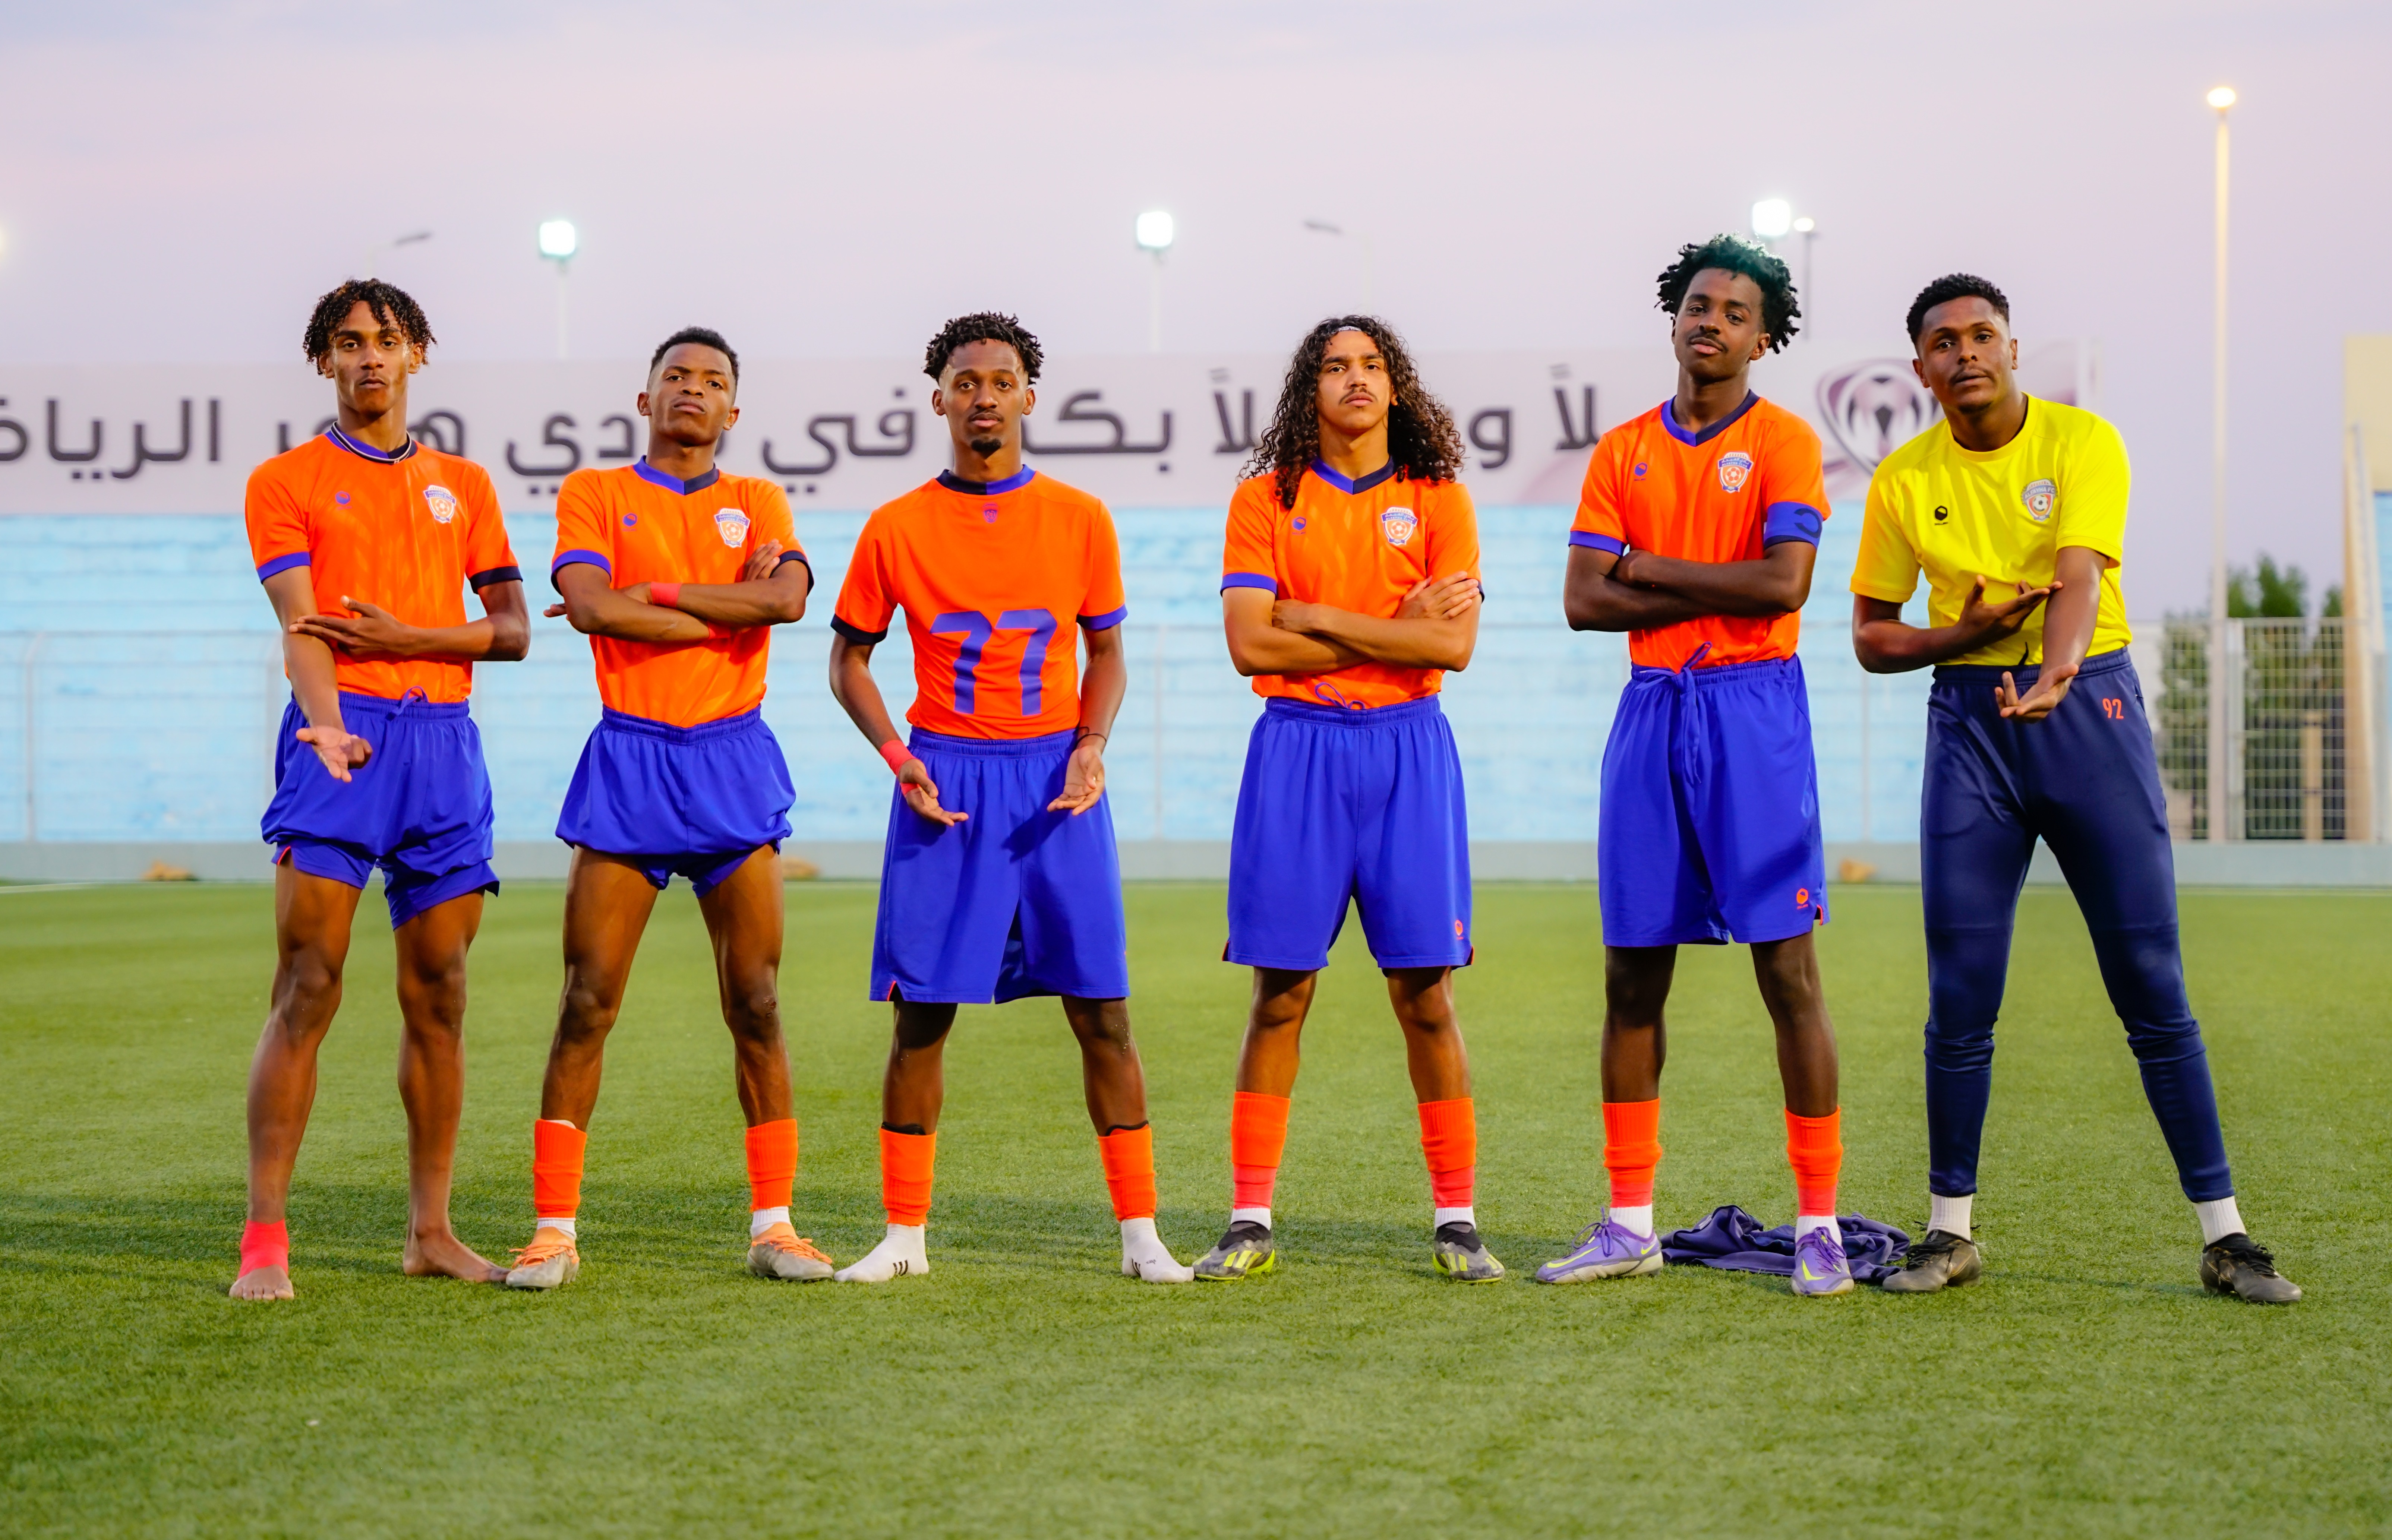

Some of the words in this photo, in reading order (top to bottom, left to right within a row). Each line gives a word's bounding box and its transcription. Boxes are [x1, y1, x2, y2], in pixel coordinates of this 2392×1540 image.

[763, 389, 915, 493] في
[951, 392, 1171, 471] بك
[2025, 486, 2047, 499] ALFAYHA
[930, 608, 1058, 716] 77
[2102, 698, 2124, 719] 92
